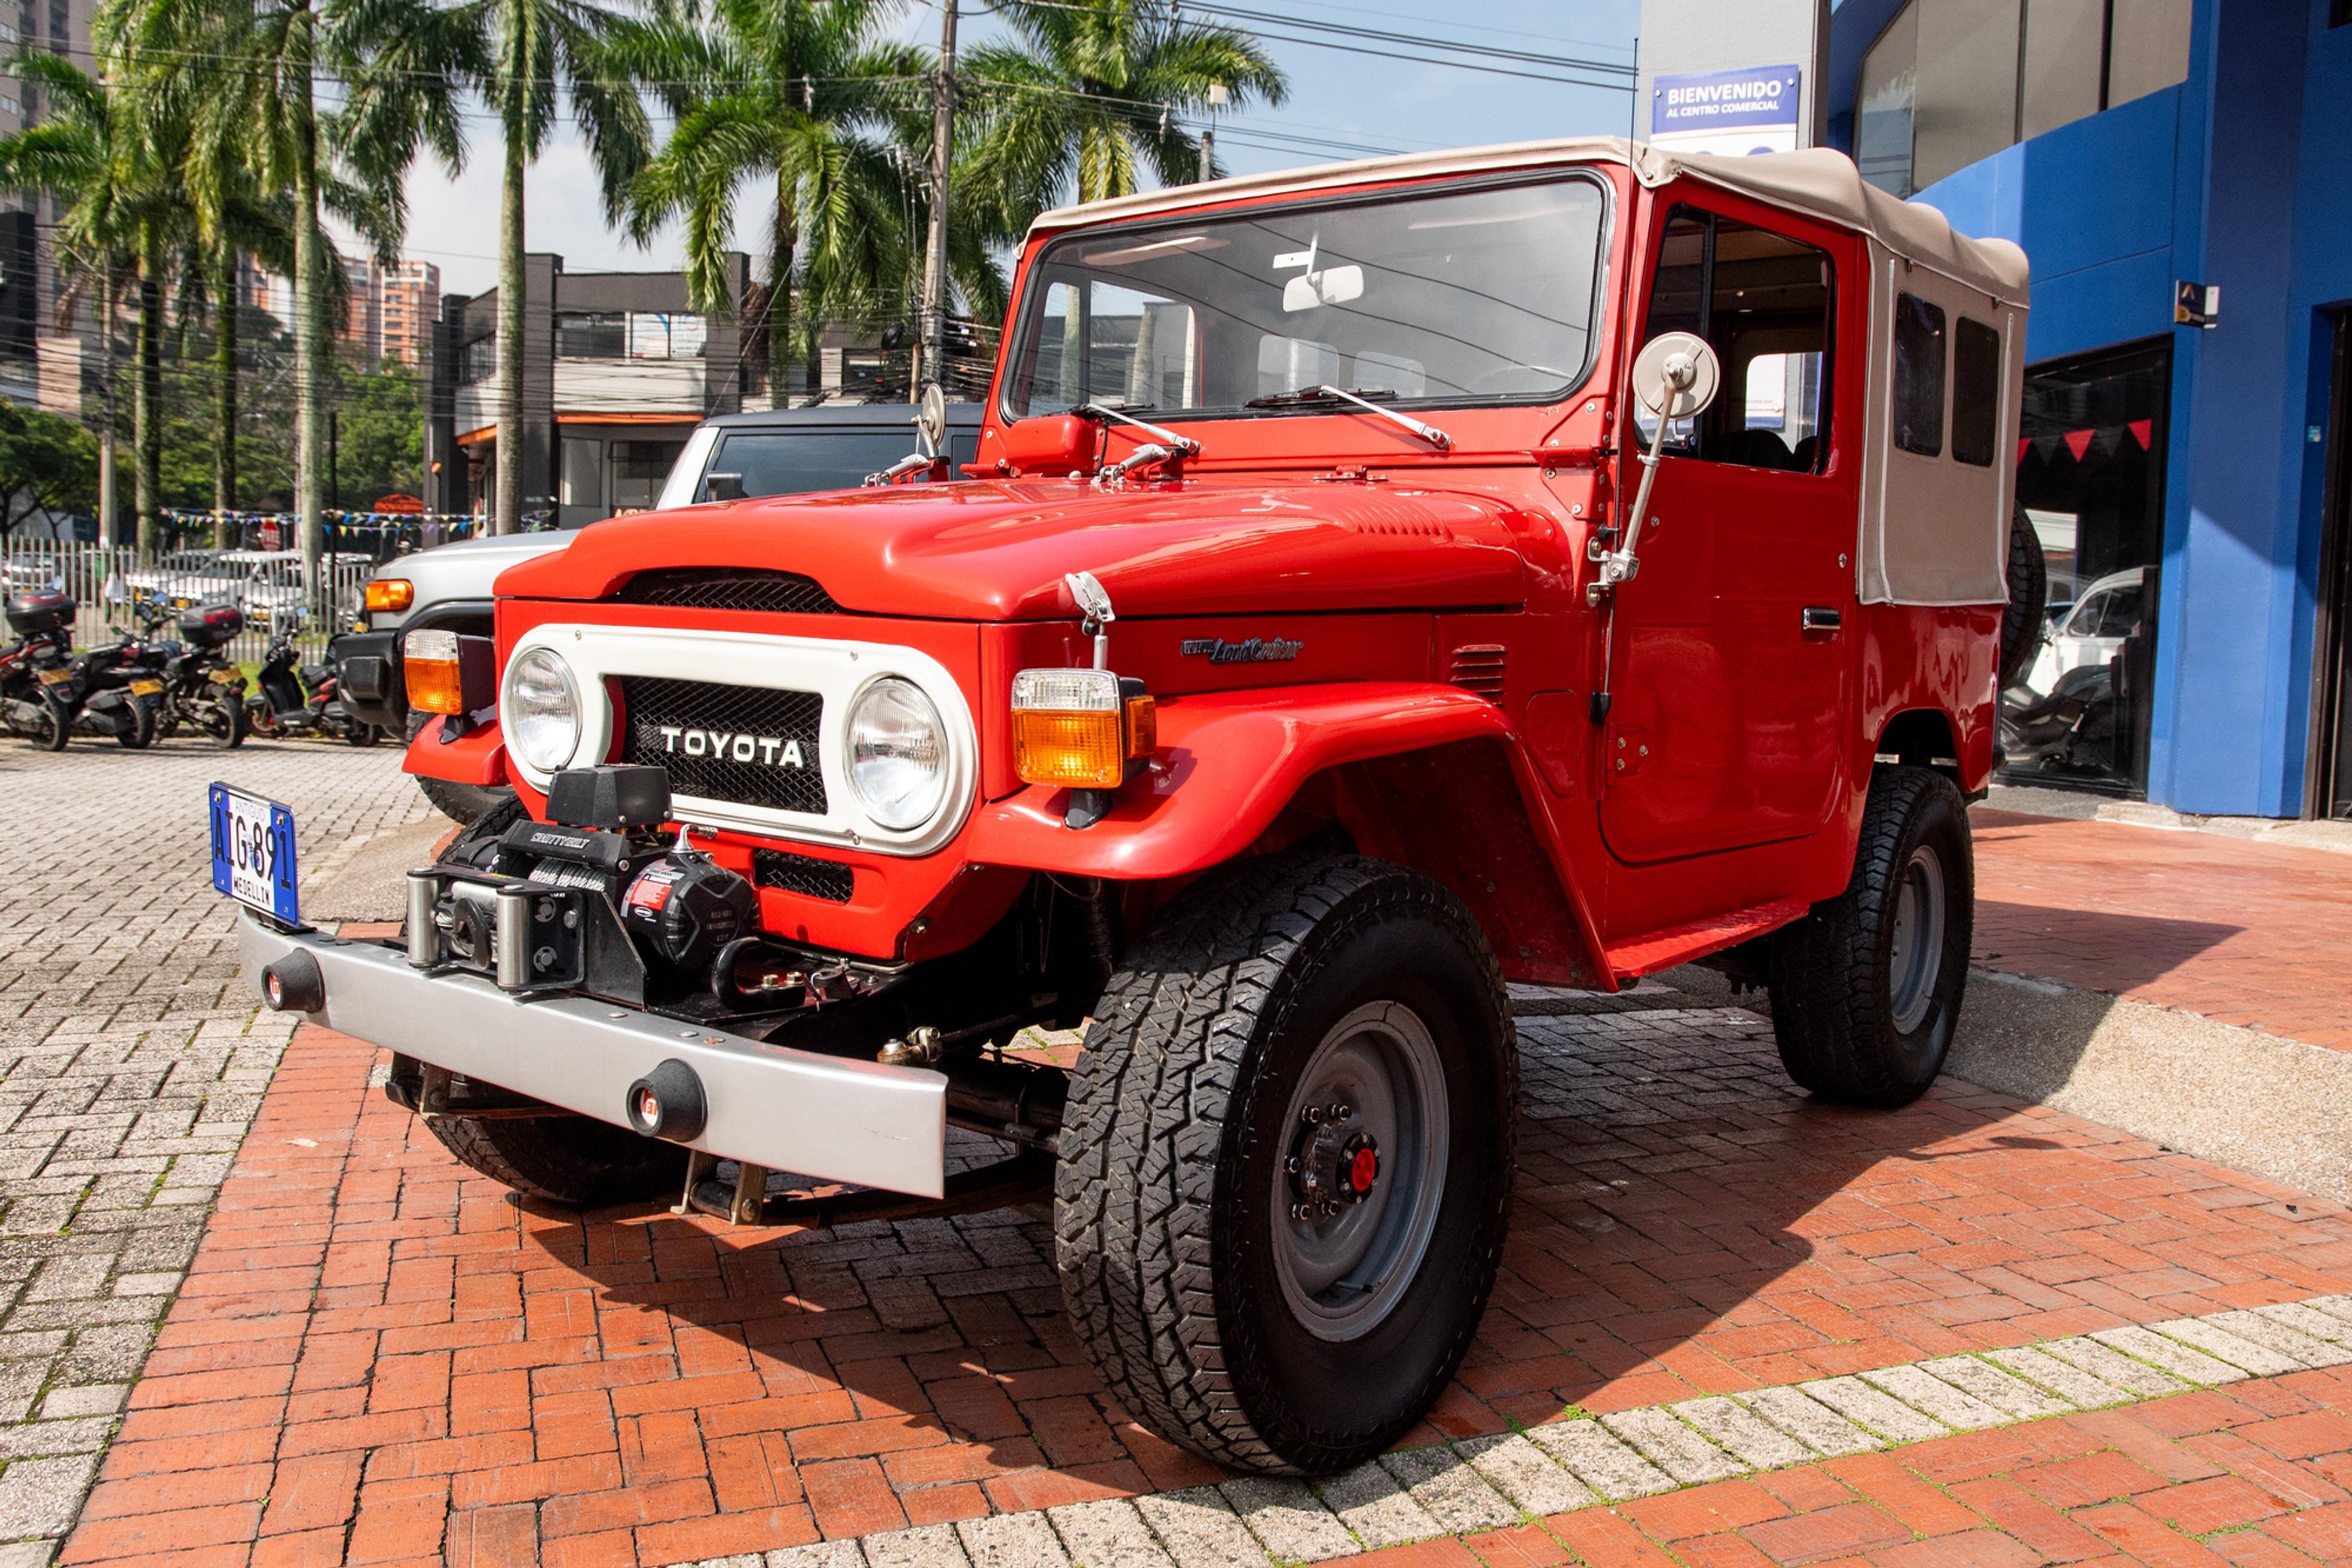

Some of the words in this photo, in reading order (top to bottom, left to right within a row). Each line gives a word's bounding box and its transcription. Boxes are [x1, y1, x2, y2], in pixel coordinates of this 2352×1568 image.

[1667, 79, 1782, 105] BIENVENIDO
[1666, 108, 1679, 118] AL
[1680, 104, 1720, 117] CENTRO
[1720, 100, 1779, 114] COMERCIAL
[1210, 638, 1251, 660] Land
[1251, 636, 1304, 660] Cruiser
[661, 725, 804, 768] TOYOTA
[235, 800, 265, 822] ANTIGUO
[234, 875, 270, 905] MEDELLIN
